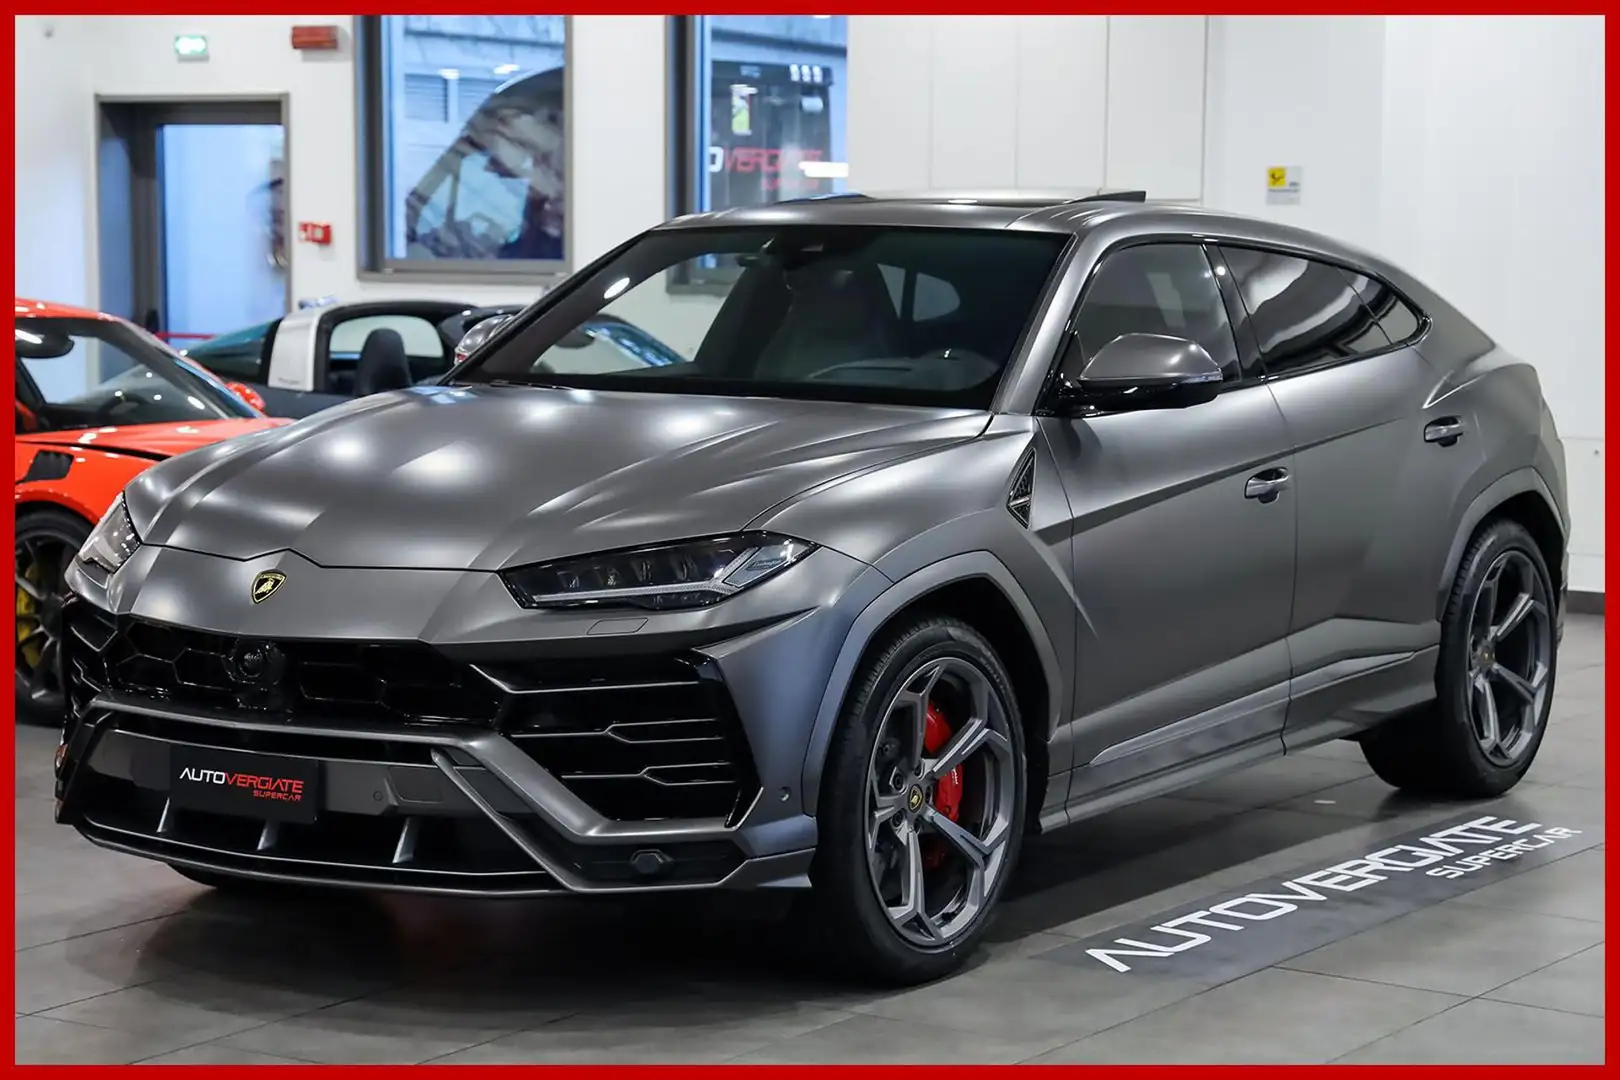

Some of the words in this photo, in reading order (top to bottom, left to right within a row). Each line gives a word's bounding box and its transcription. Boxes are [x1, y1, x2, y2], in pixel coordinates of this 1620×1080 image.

[179, 767, 305, 794] AUTOVERGIATE
[253, 790, 302, 802] SUPERCAR
[1425, 826, 1584, 879] SUPERCAR
[1085, 815, 1543, 973] AUTOVERGIATE
